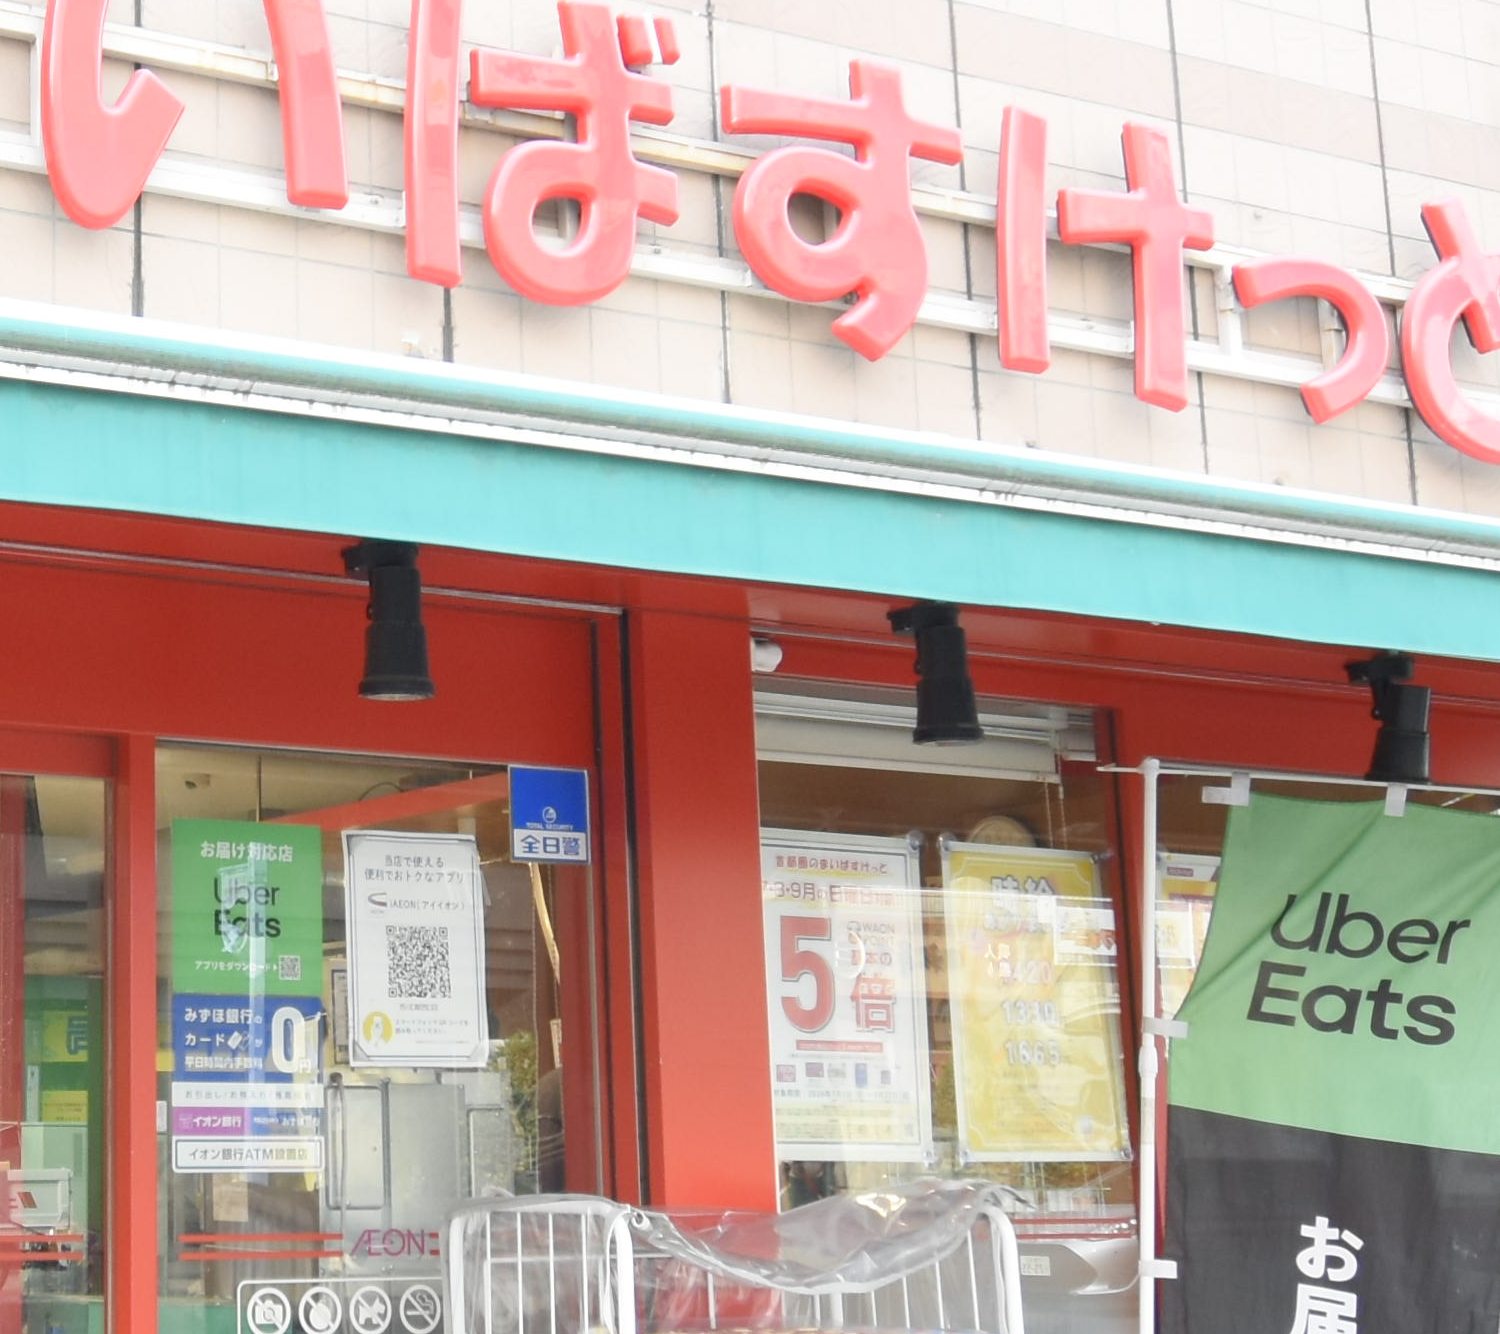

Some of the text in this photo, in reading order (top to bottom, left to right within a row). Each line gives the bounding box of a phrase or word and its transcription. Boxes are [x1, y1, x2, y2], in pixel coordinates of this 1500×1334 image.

[200, 841, 293, 862] お届け対応店
[521, 834, 581, 855] 全日警
[214, 877, 280, 906] Uber
[214, 909, 281, 938] Eats
[1269, 893, 1476, 966] Uber
[780, 916, 835, 1033] 5
[851, 973, 896, 1032] 倍
[1246, 961, 1458, 1044] Eats
[185, 1032, 225, 1046] カード
[272, 1006, 305, 1074] 0
[193, 1116, 242, 1128] イオン銀行
[189, 1148, 308, 1161] イオン銀行ATM設置店
